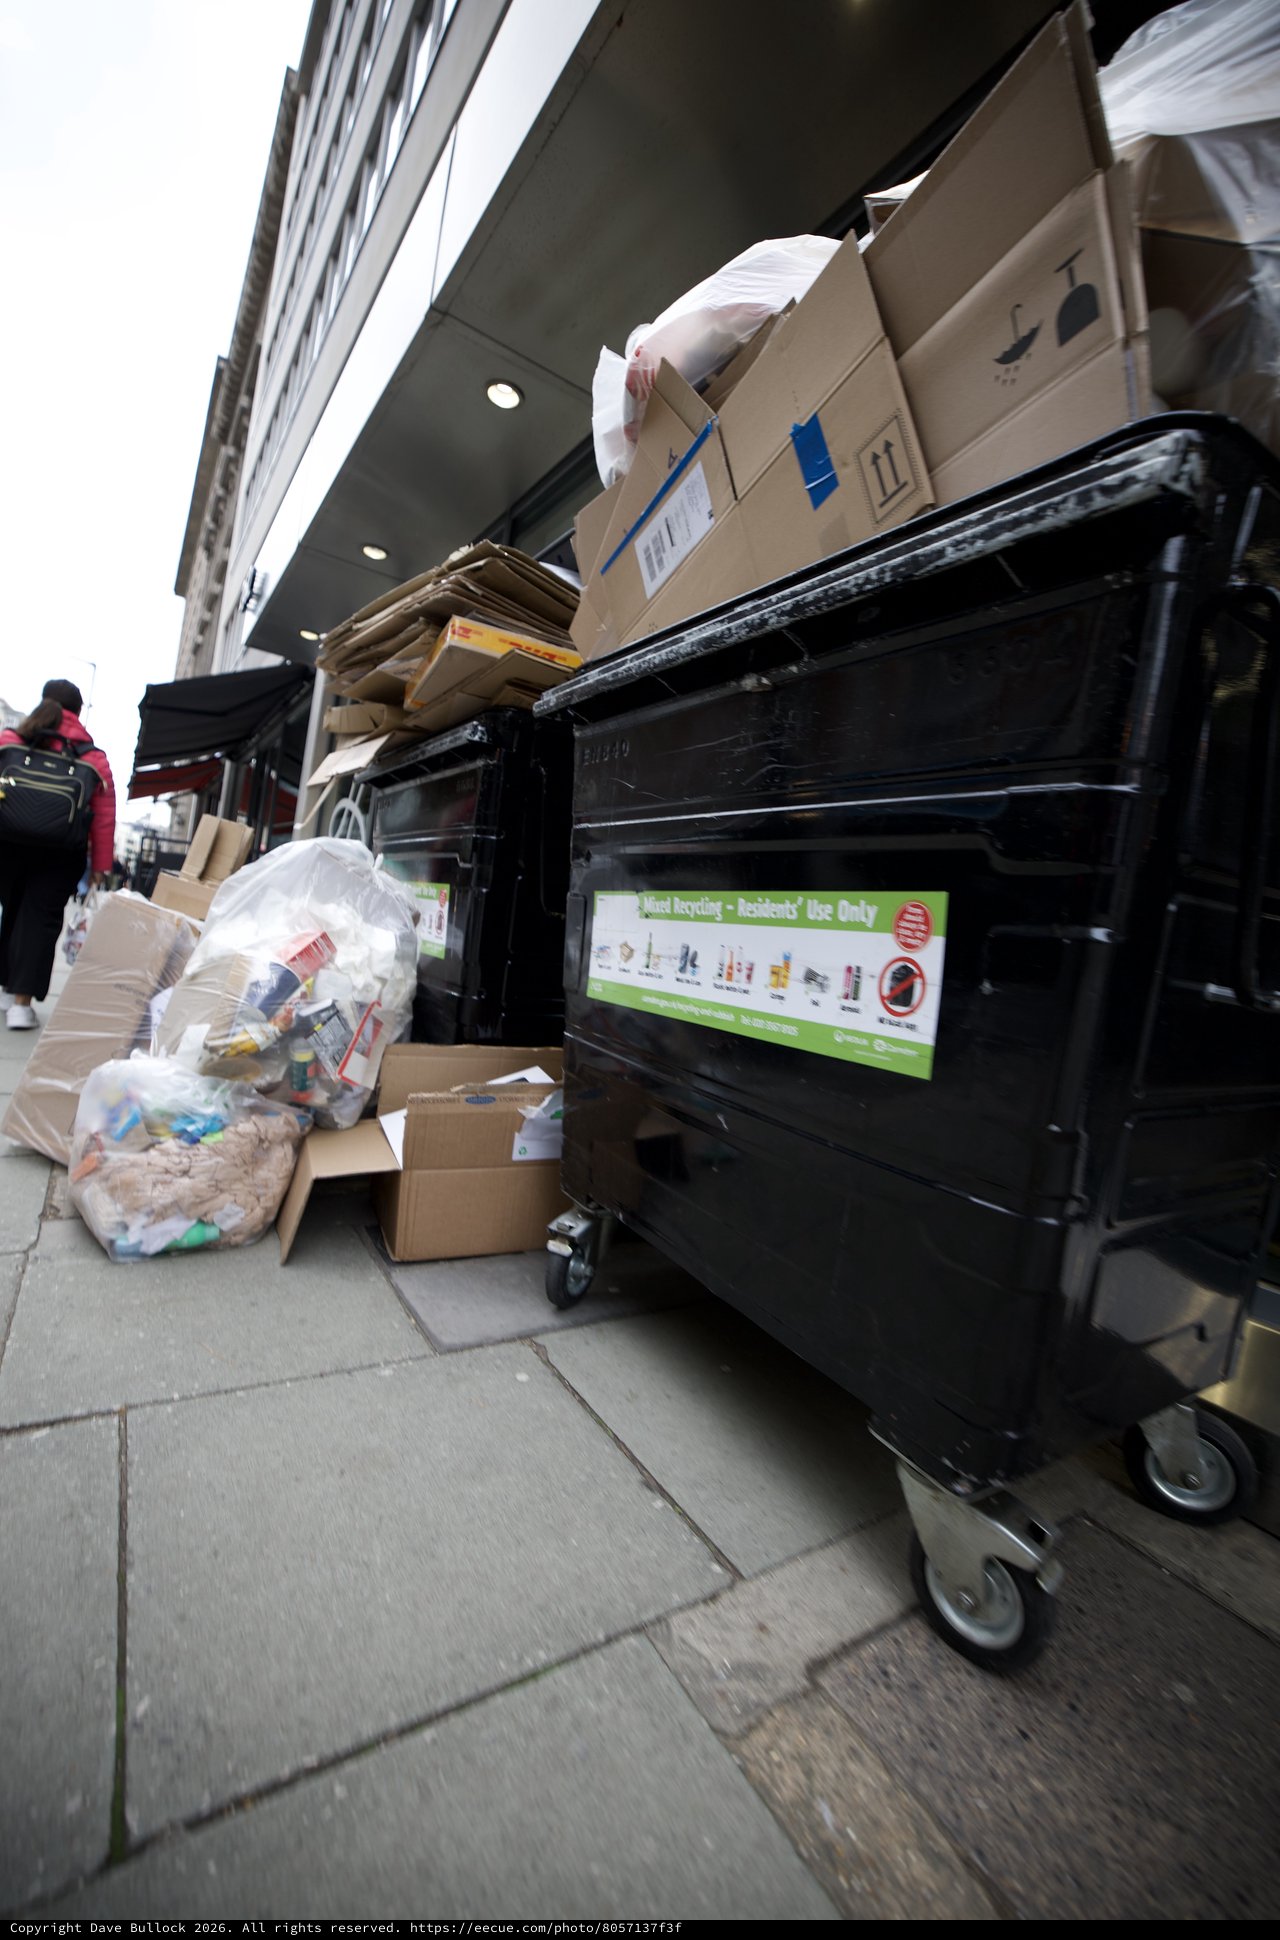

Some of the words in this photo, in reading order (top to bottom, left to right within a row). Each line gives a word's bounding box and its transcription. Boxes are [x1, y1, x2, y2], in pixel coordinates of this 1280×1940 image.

[643, 896, 671, 914] Mixed
[673, 897, 722, 921] Recycling
[737, 896, 804, 920] Residents'
[806, 899, 832, 921] Use
[837, 899, 878, 928] Only
